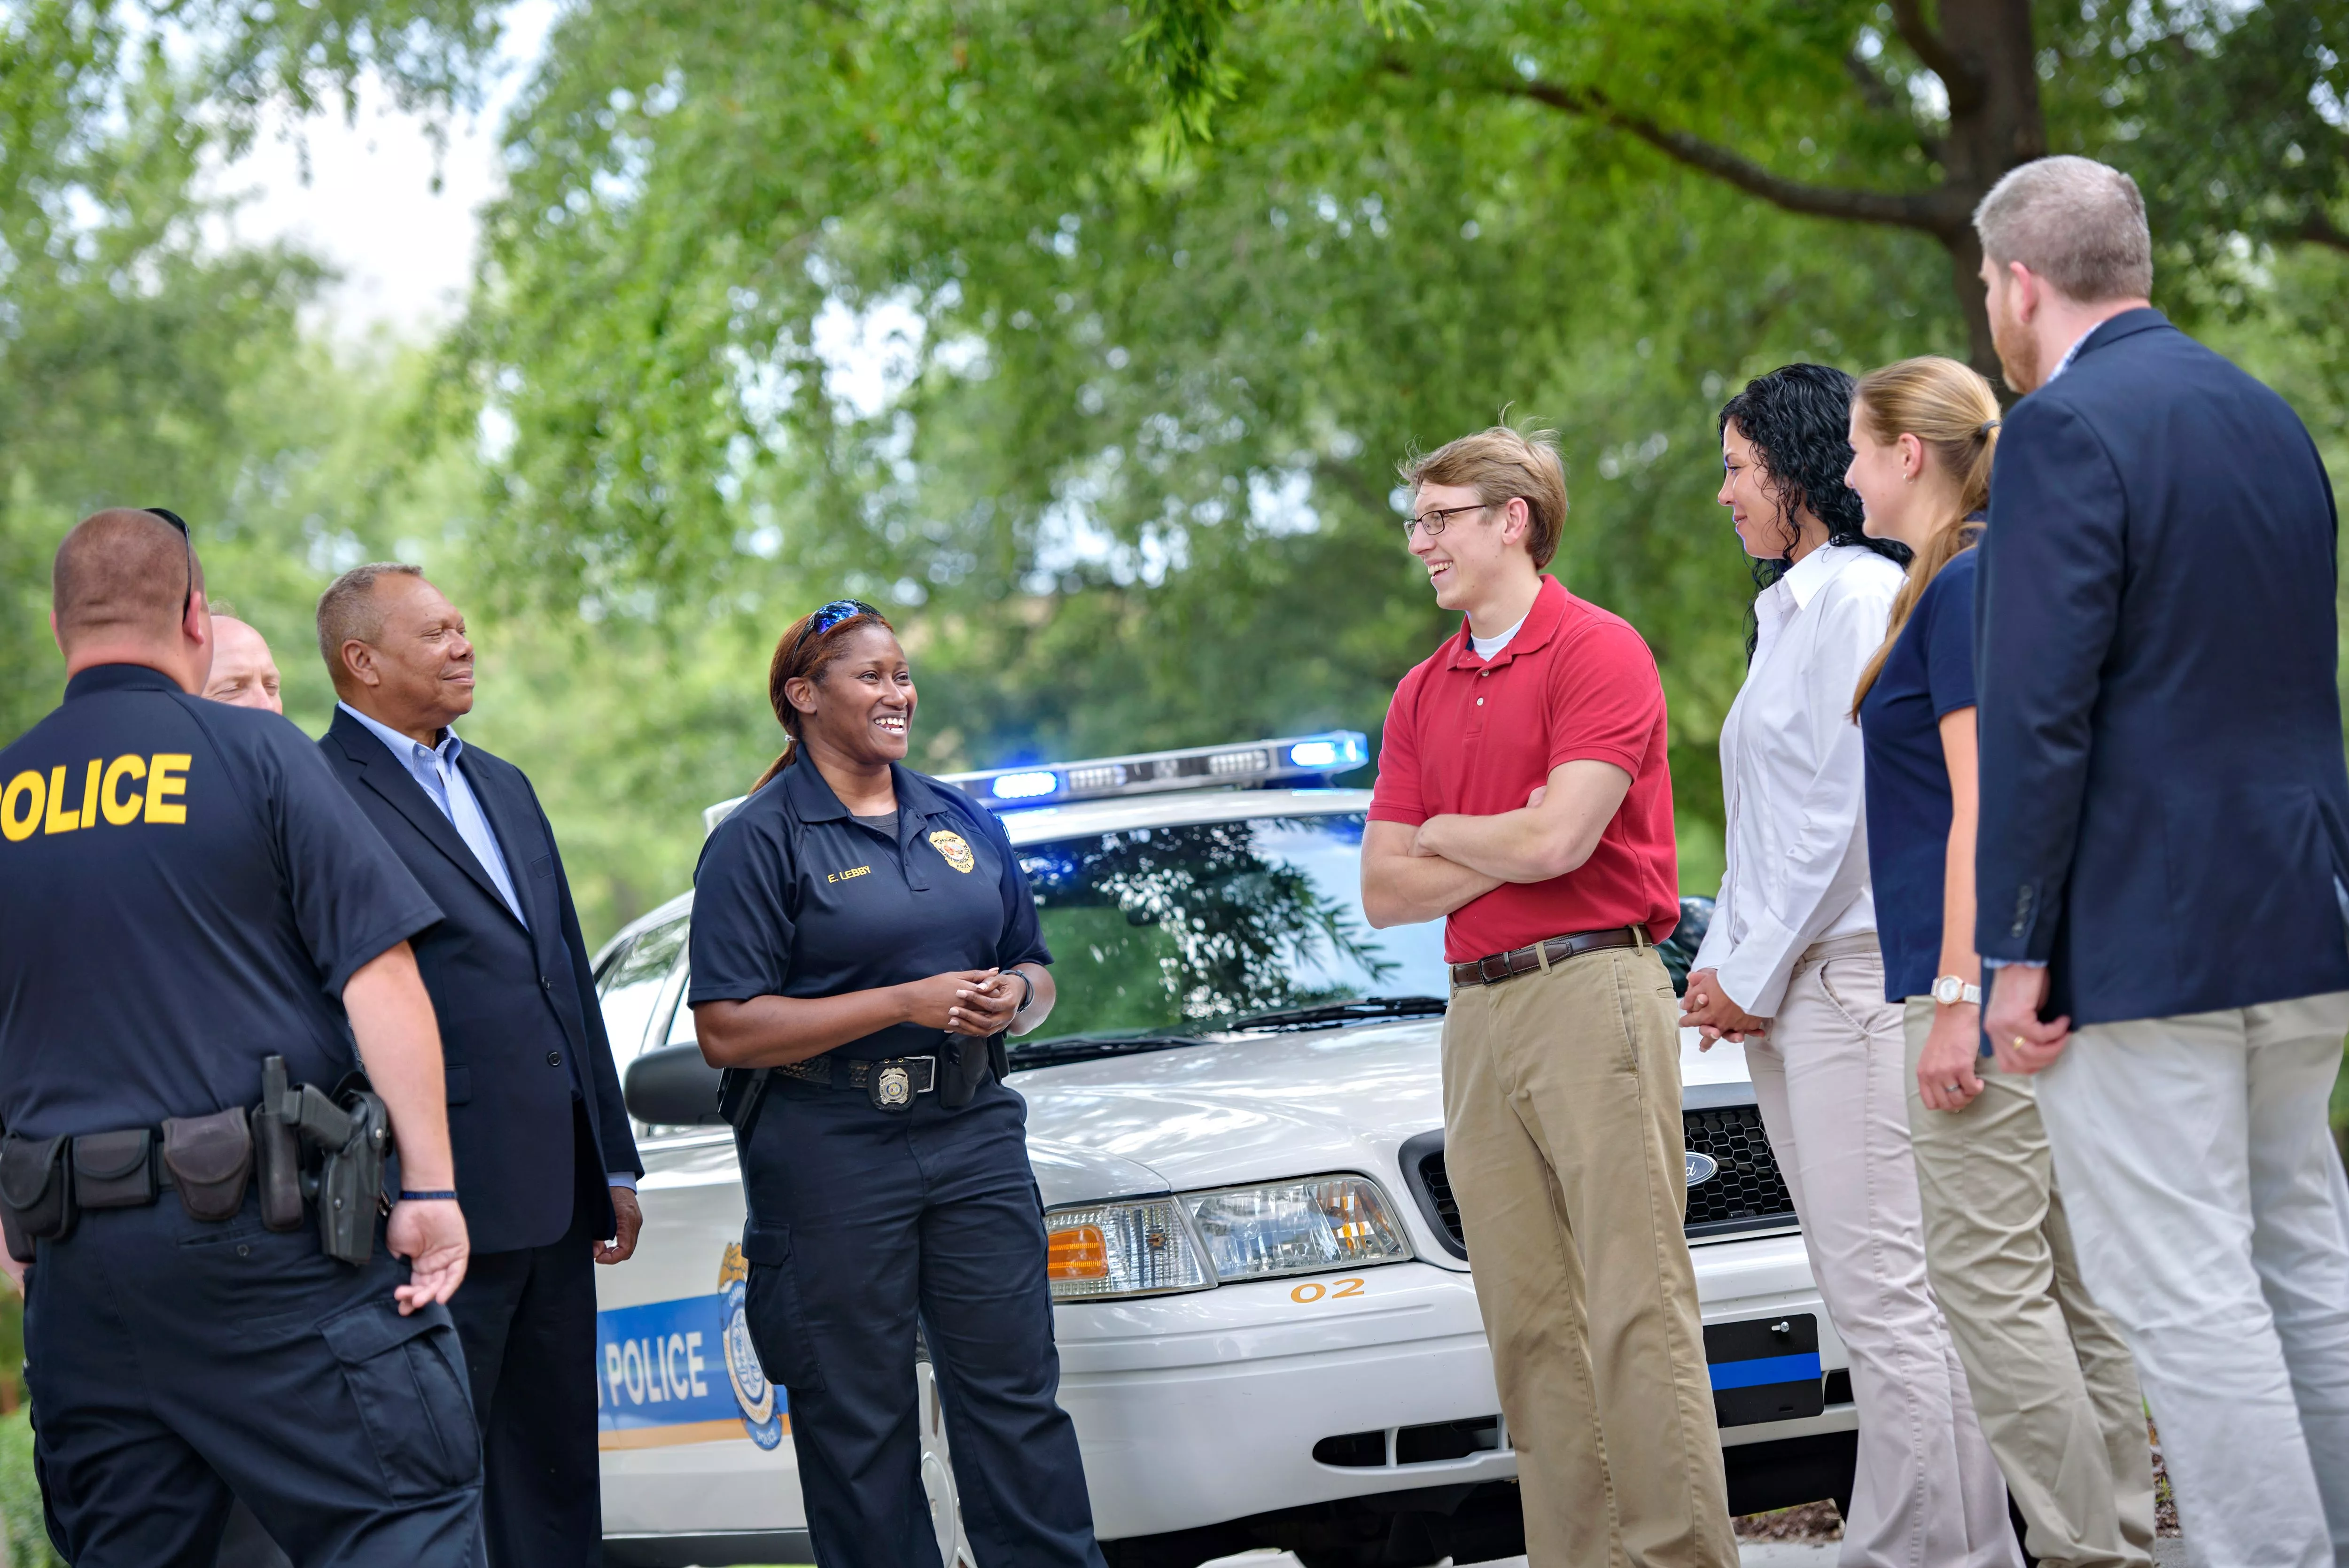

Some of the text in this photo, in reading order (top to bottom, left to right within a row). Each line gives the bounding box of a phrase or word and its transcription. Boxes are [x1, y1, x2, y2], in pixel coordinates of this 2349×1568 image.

[0, 754, 192, 842] OLICE
[827, 866, 871, 883] E. LEBBY
[605, 1332, 708, 1406] POLICE
[756, 1428, 778, 1445] POLICE
